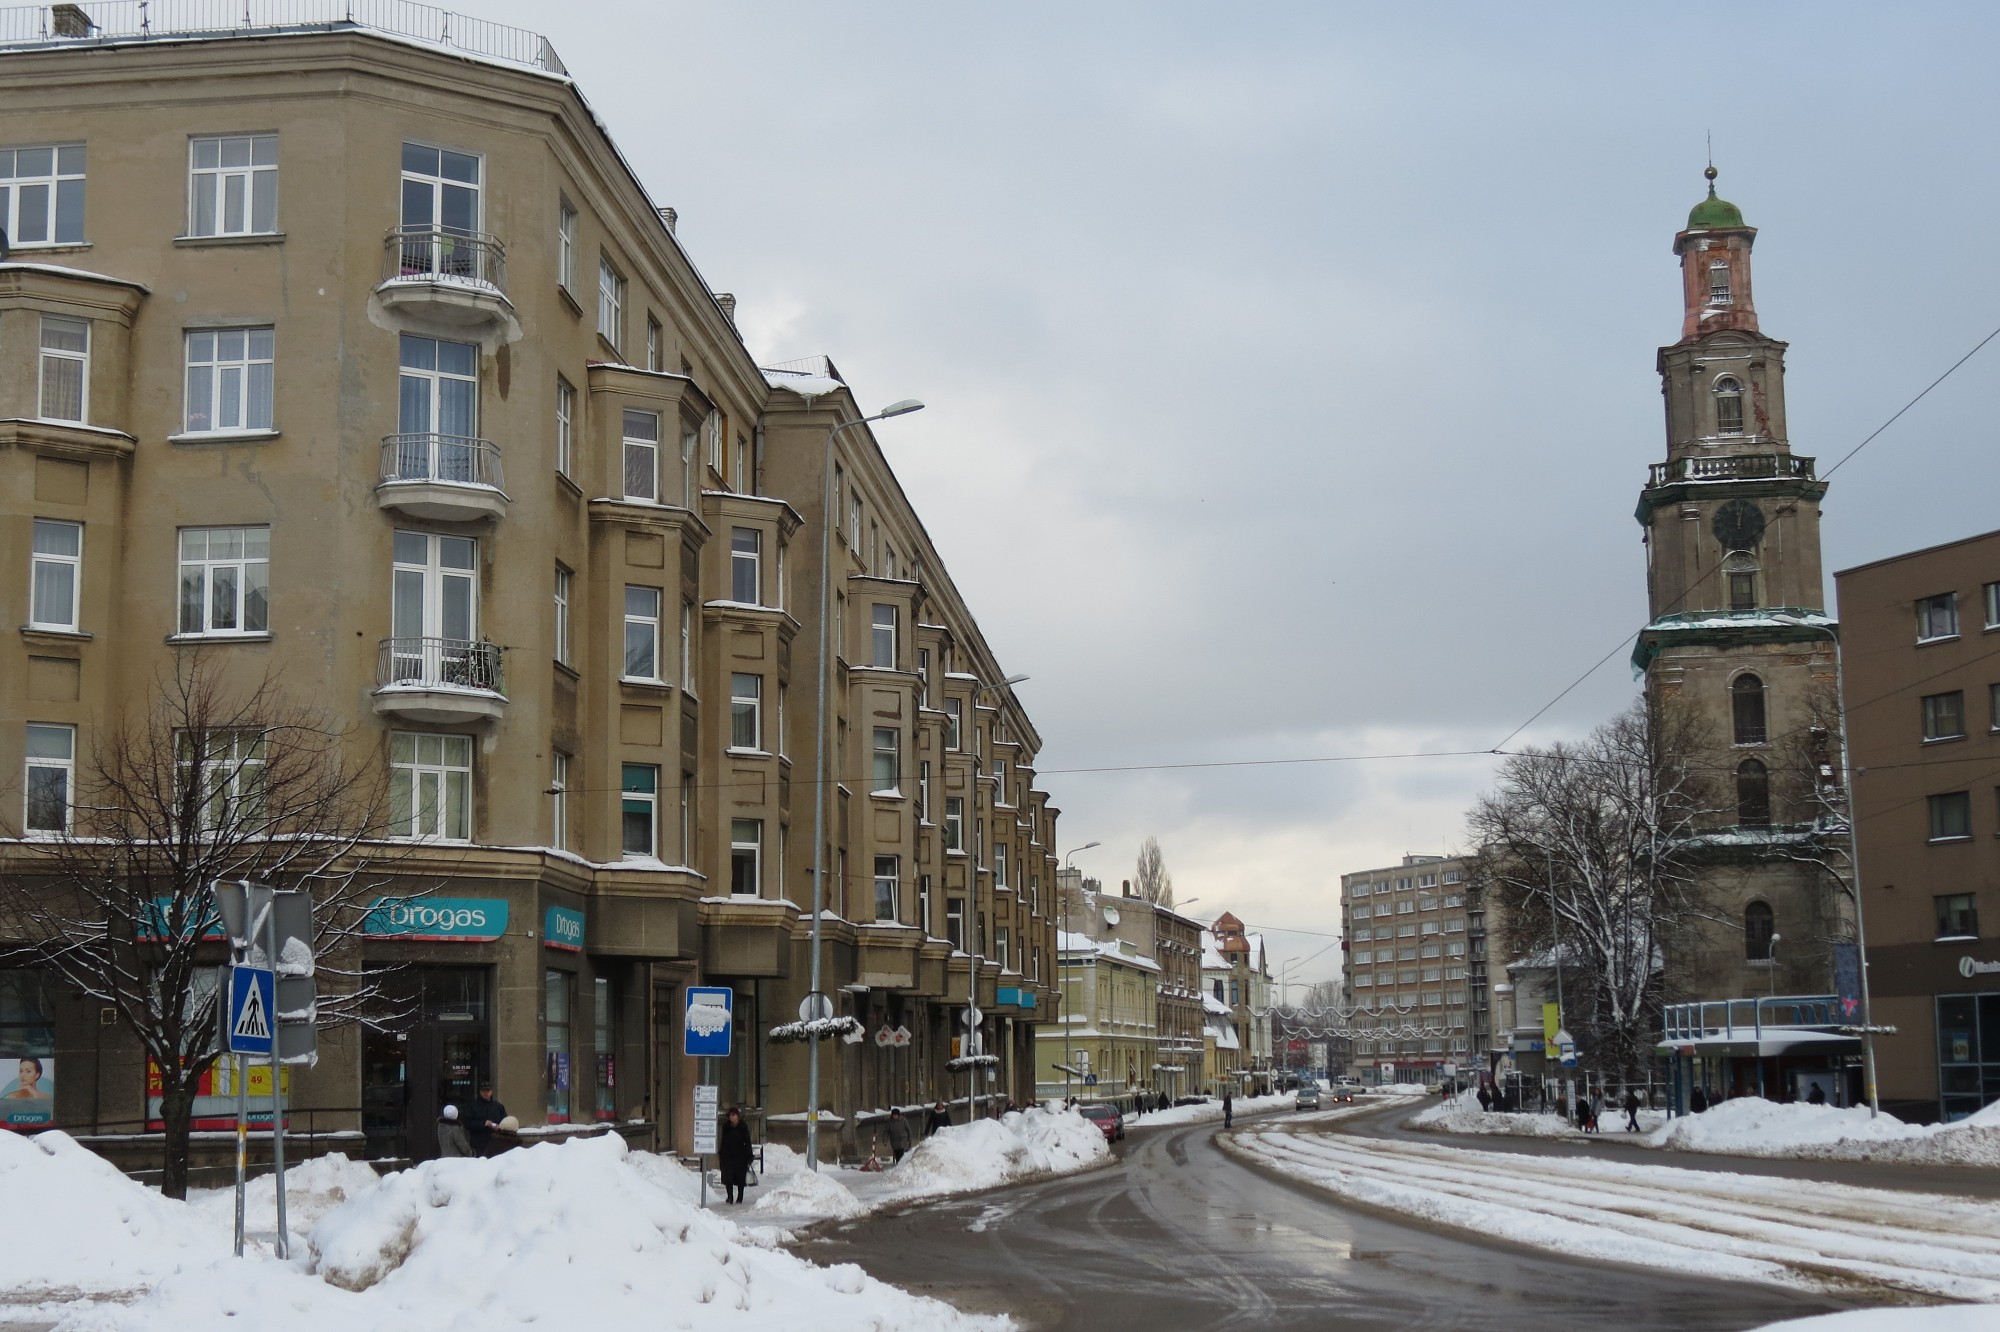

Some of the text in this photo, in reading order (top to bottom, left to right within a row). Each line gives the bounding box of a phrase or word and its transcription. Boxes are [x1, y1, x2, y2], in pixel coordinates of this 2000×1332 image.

[390, 905, 486, 931] Drogas
[556, 914, 579, 940] Drogas
[250, 1075, 263, 1084] 49
[13, 1114, 43, 1123] Drogas
